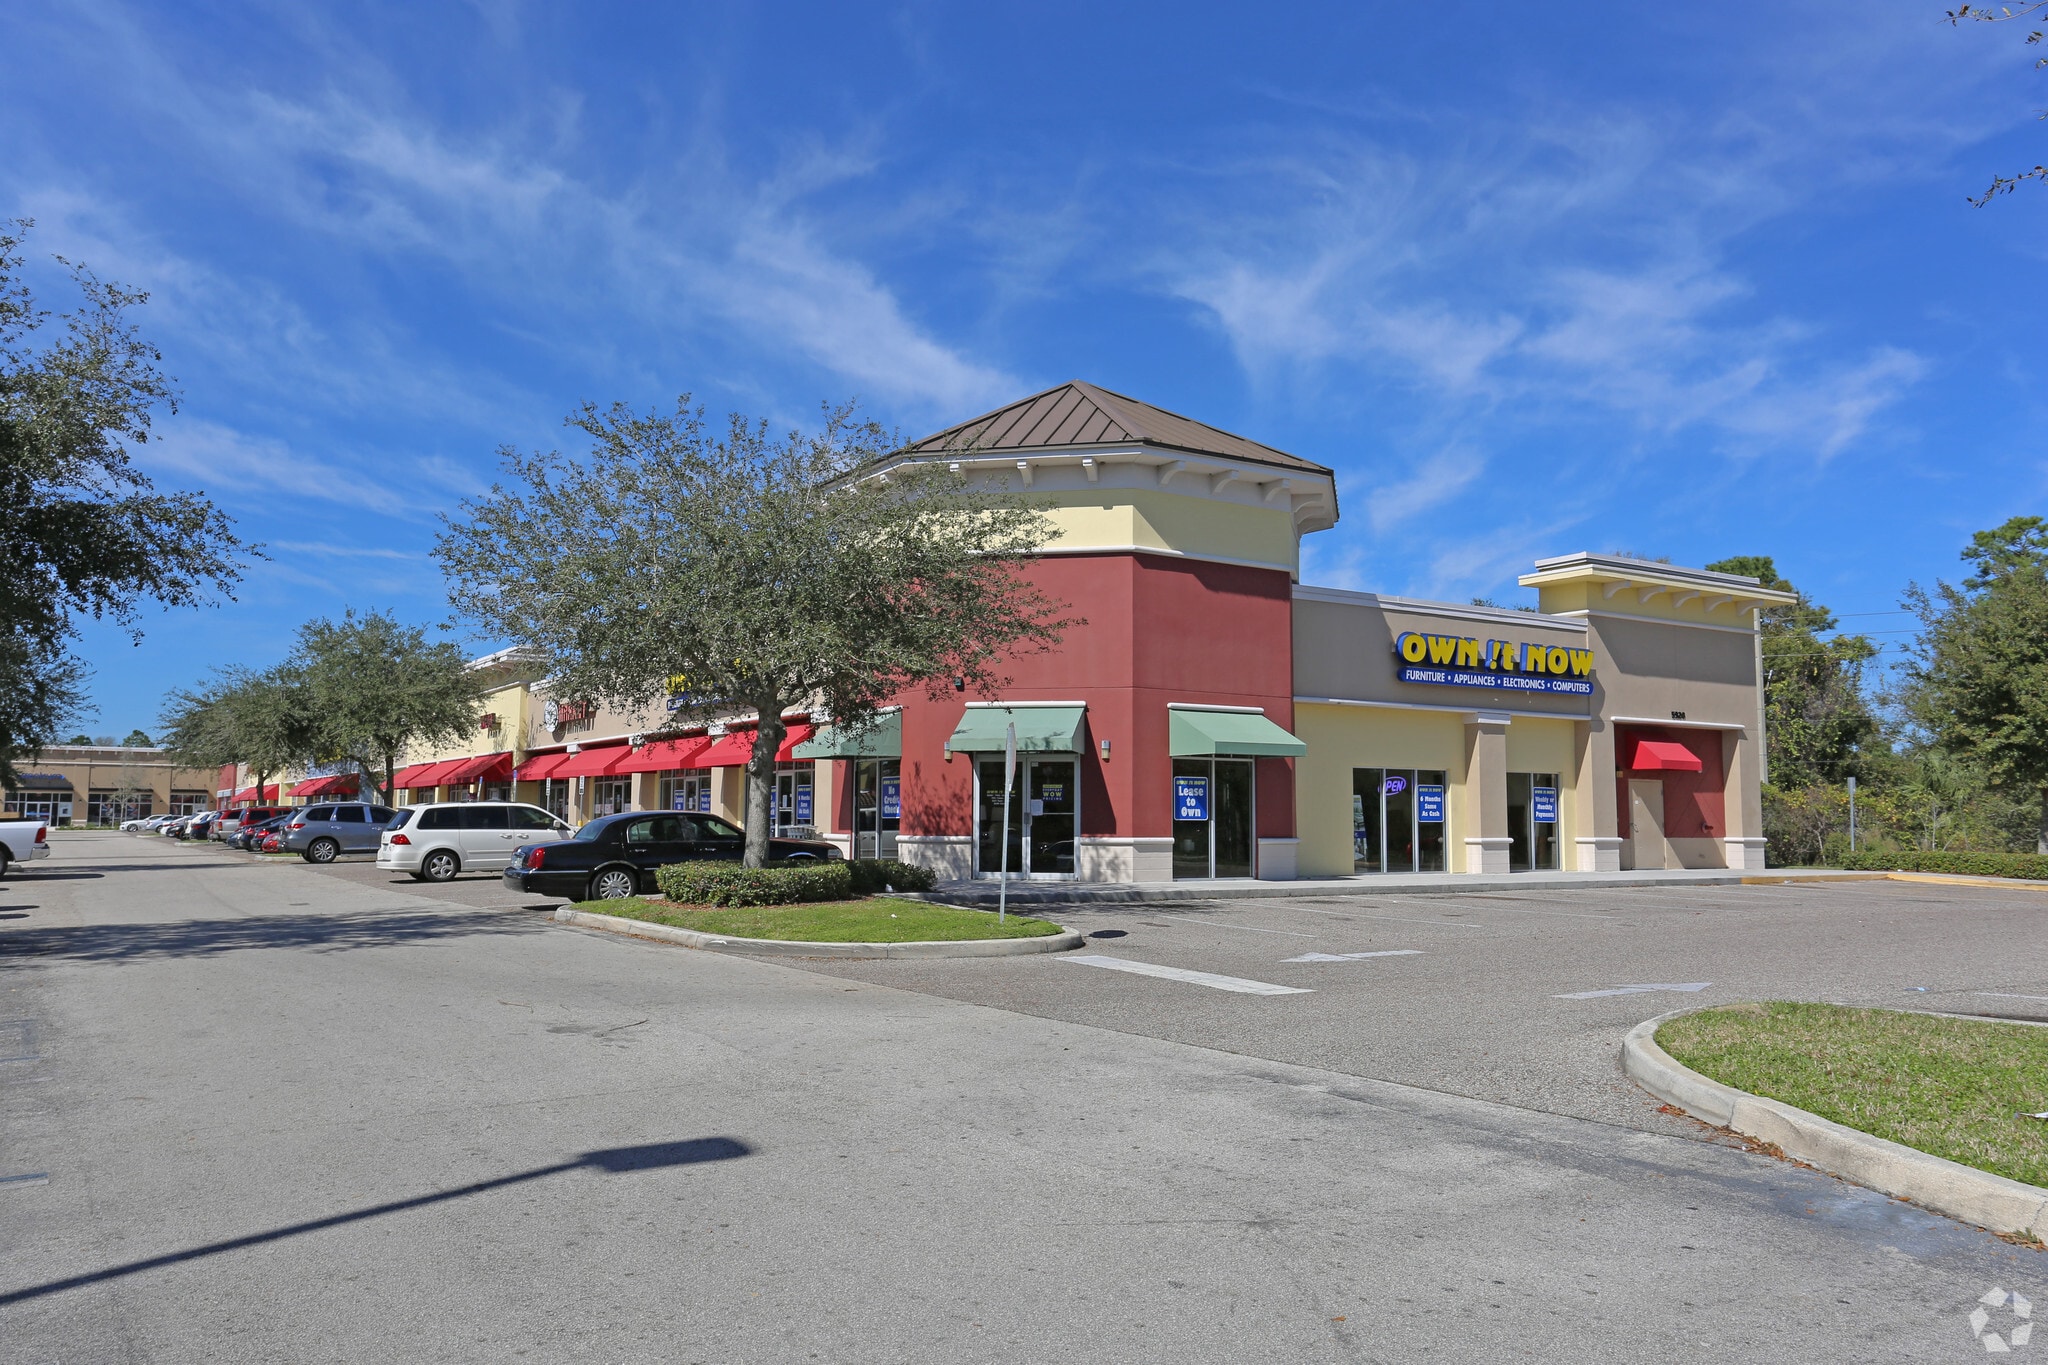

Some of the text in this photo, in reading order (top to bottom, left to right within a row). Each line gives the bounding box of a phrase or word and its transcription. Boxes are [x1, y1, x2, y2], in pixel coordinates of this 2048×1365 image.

[1399, 632, 1479, 667] OWN
[1523, 643, 1595, 677] NOW
[1405, 671, 1590, 693] FURNITURE APPLIANCES ELECTRONICS COMPUTERS
[1178, 785, 1204, 797] Lease
[1385, 780, 1403, 792] PEN
[1186, 796, 1196, 807] to
[1181, 806, 1201, 817] Own
